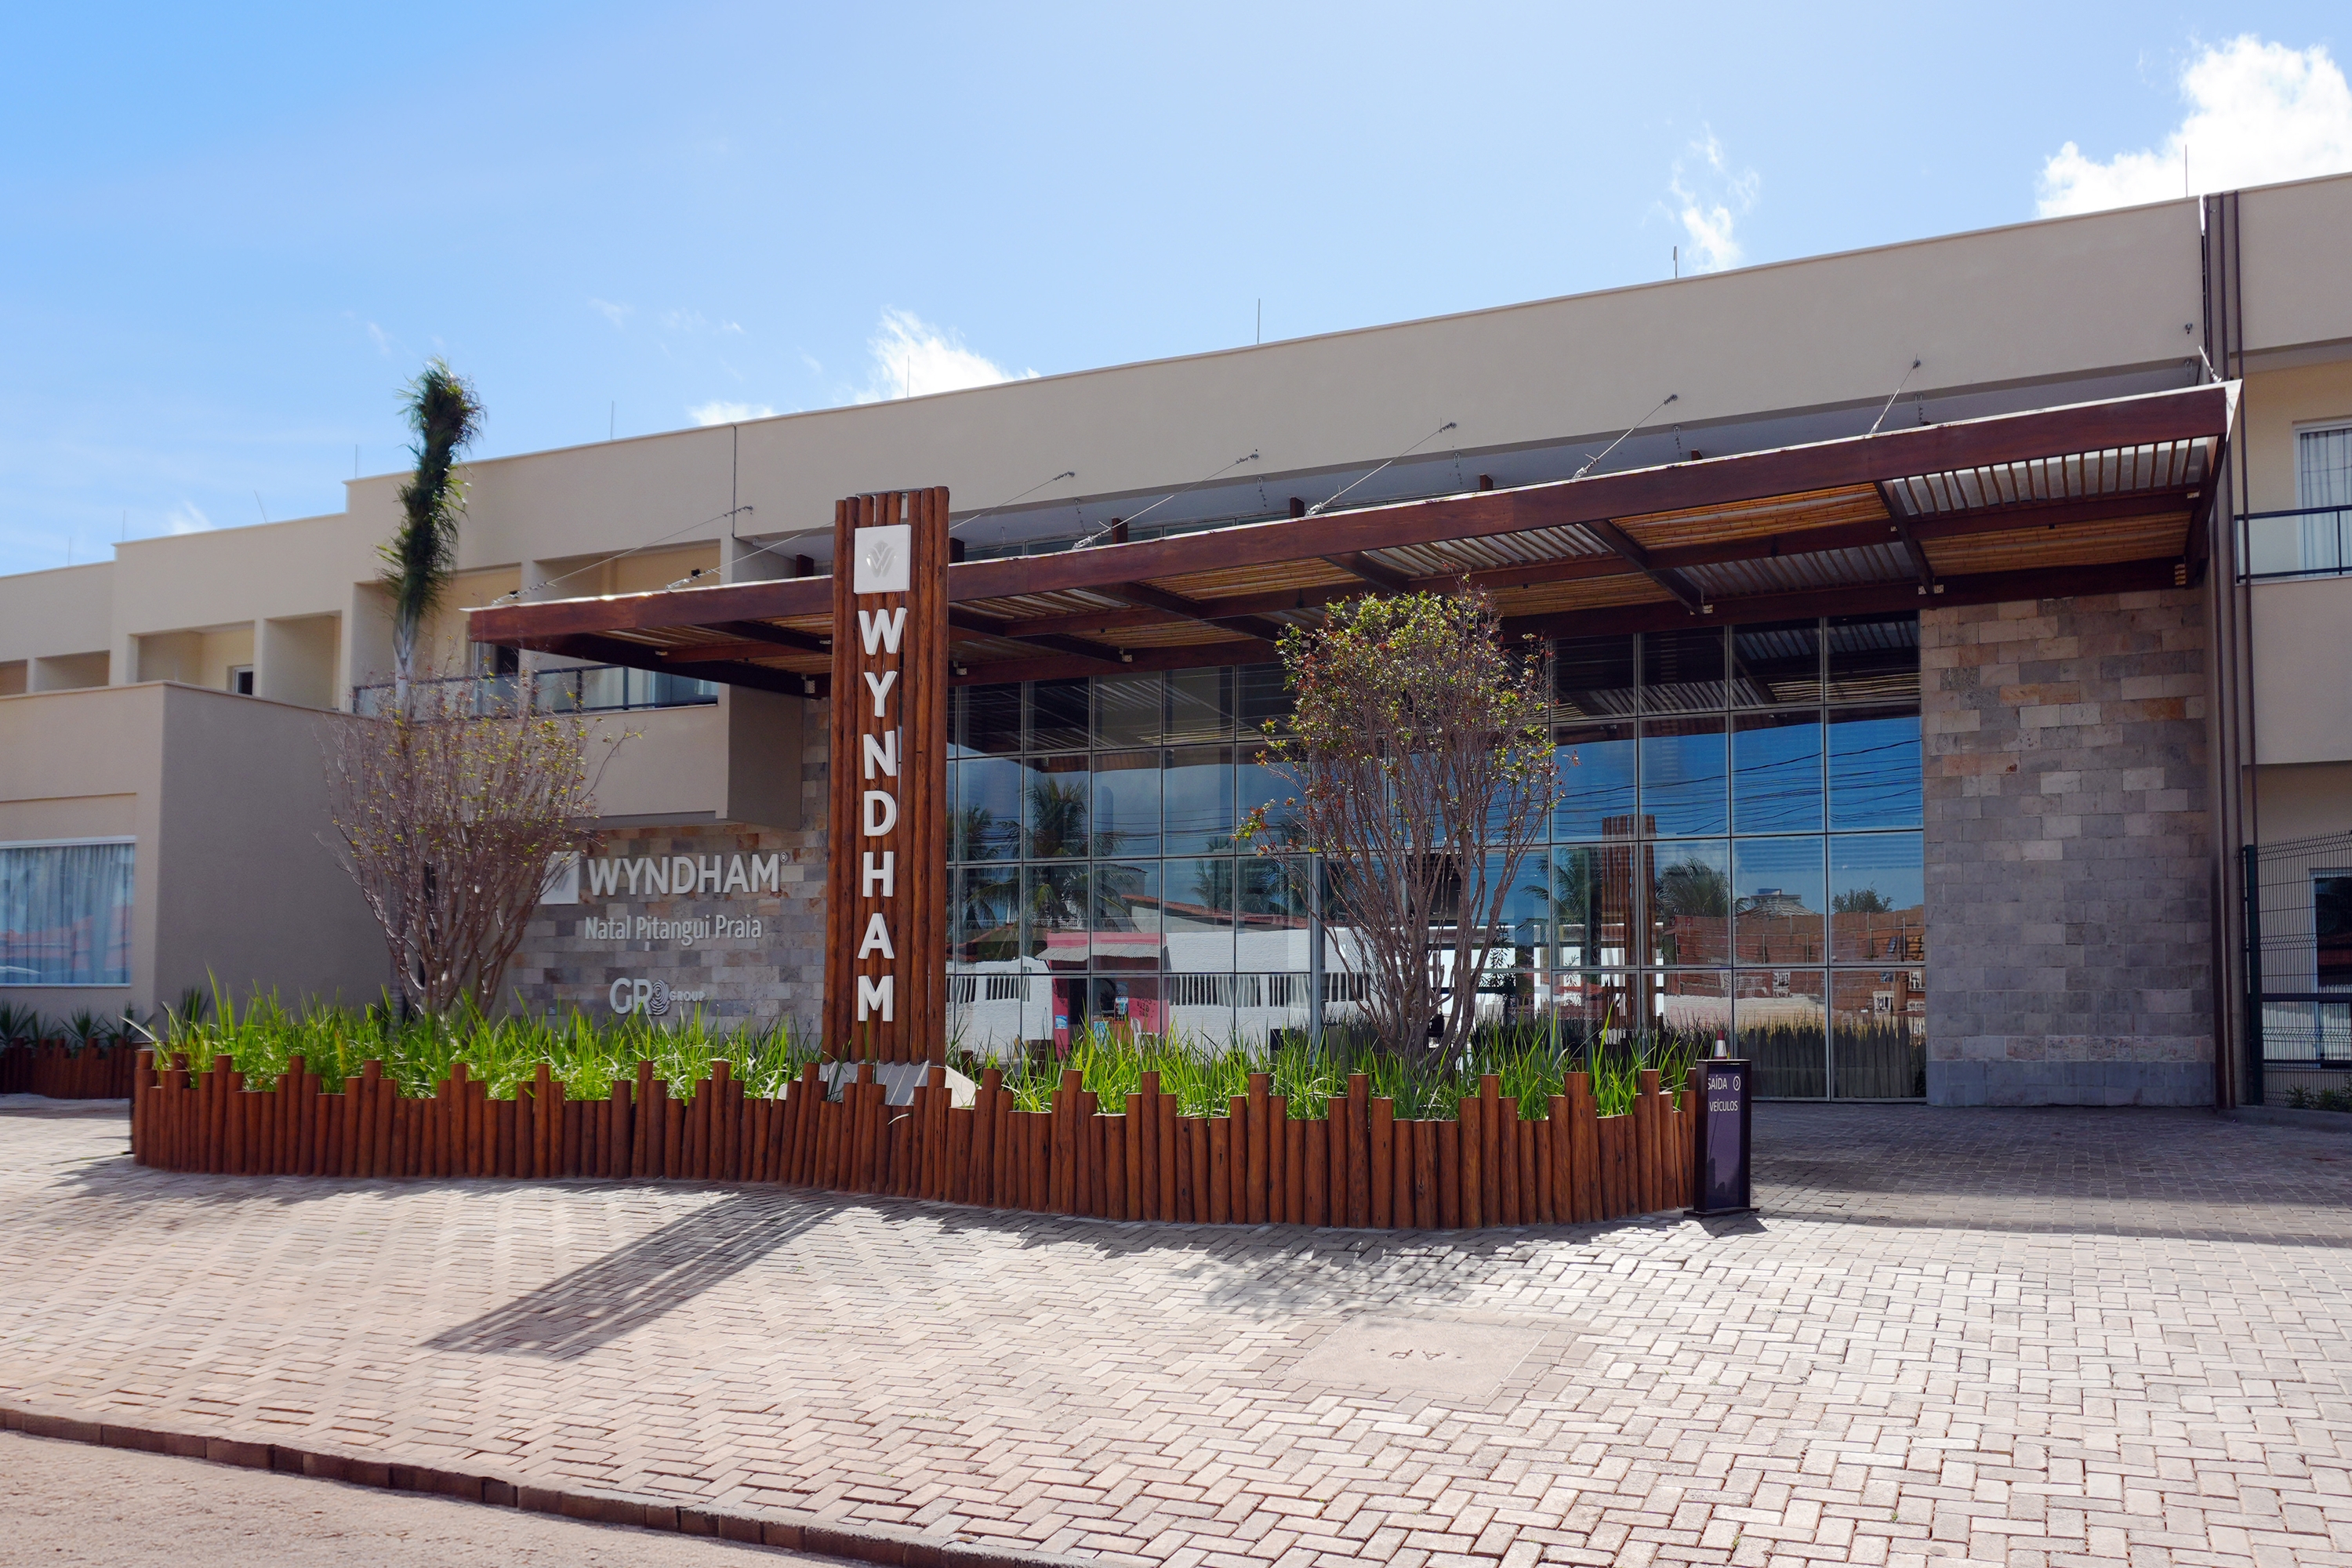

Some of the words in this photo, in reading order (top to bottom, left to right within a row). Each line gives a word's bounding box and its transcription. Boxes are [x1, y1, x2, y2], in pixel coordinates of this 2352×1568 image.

[857, 607, 908, 1022] WYNDHAM
[585, 916, 631, 939] Natal
[636, 915, 710, 946] Pitangui
[715, 914, 762, 938] Praia
[669, 991, 706, 1001] GROUP
[1708, 1075, 1727, 1090] SAÍDA
[1710, 1098, 1738, 1112] VEÍCULOS
